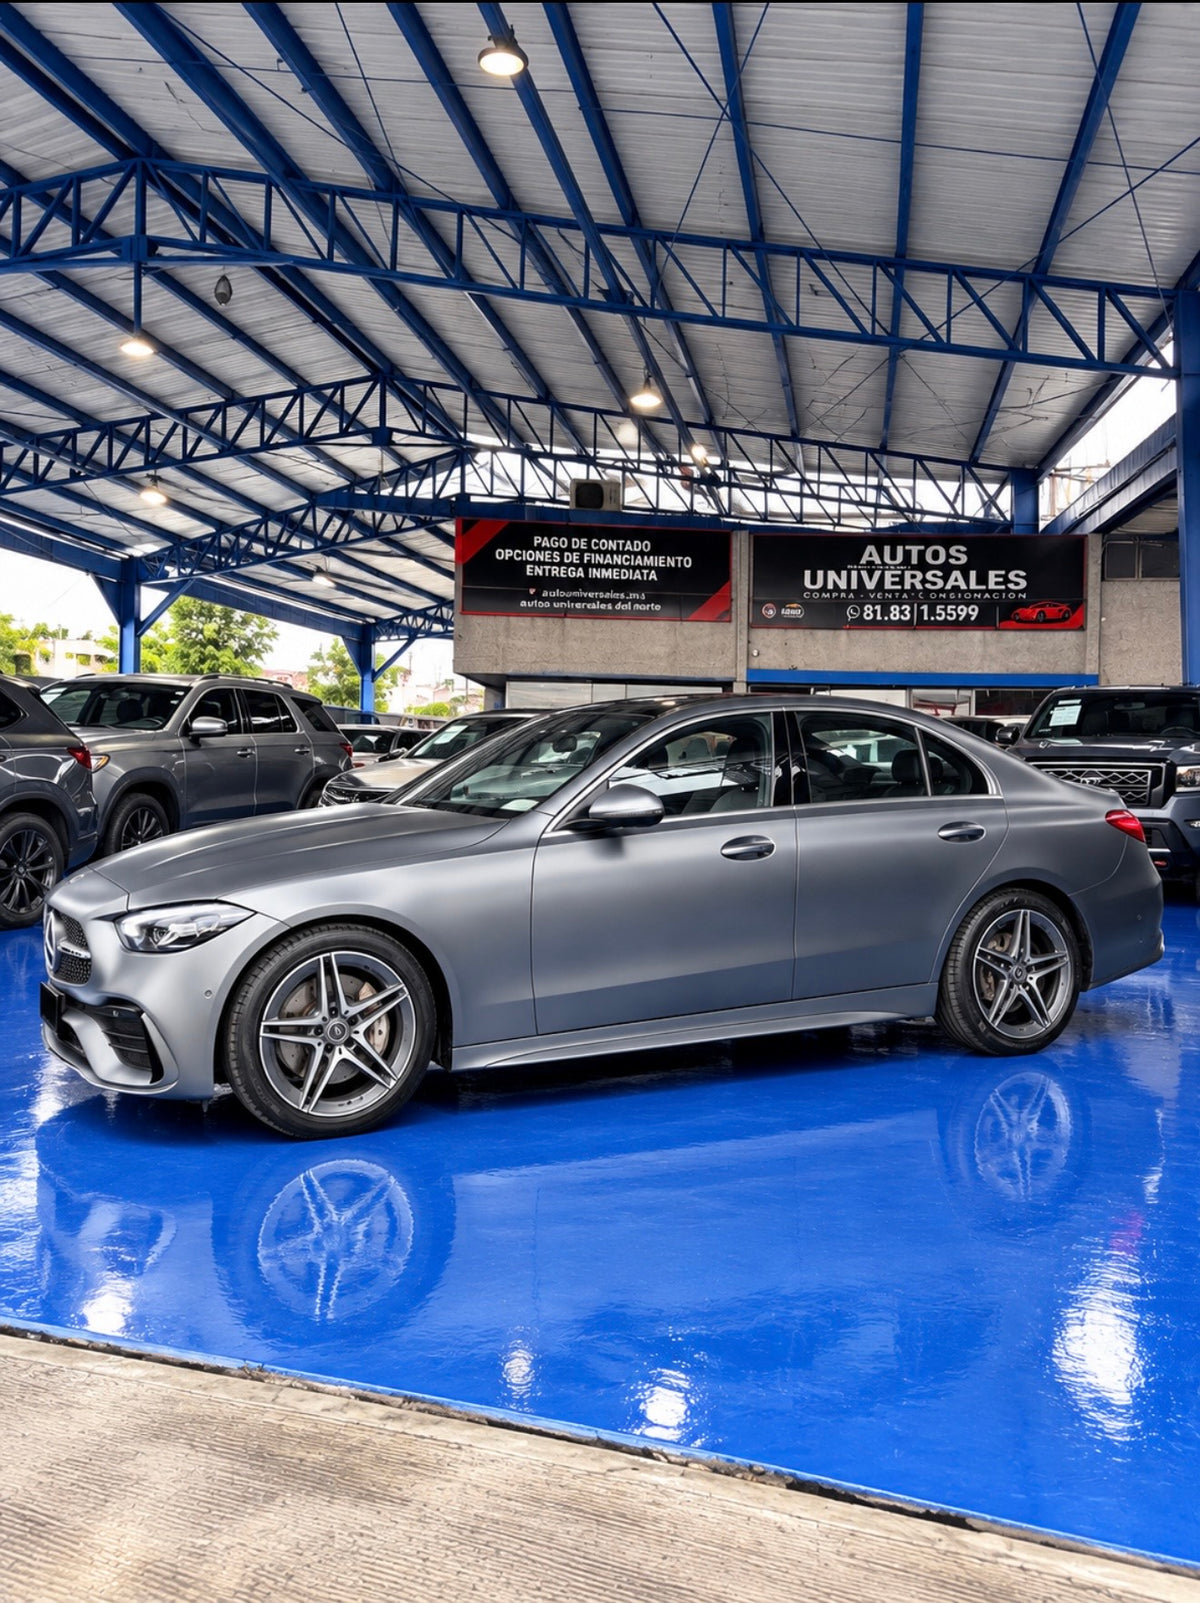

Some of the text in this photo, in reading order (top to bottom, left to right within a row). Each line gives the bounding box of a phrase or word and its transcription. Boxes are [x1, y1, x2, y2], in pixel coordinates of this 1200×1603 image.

[533, 536, 651, 552] PAGO DE CONTADO
[495, 549, 692, 568] OPCIONES DE FINANCIAMIENTO
[860, 544, 968, 565] AUTOS
[526, 564, 658, 581] ENTREGA INMEDIATA
[803, 570, 1028, 591] UNIVERSALES
[803, 591, 855, 599] COMPRA
